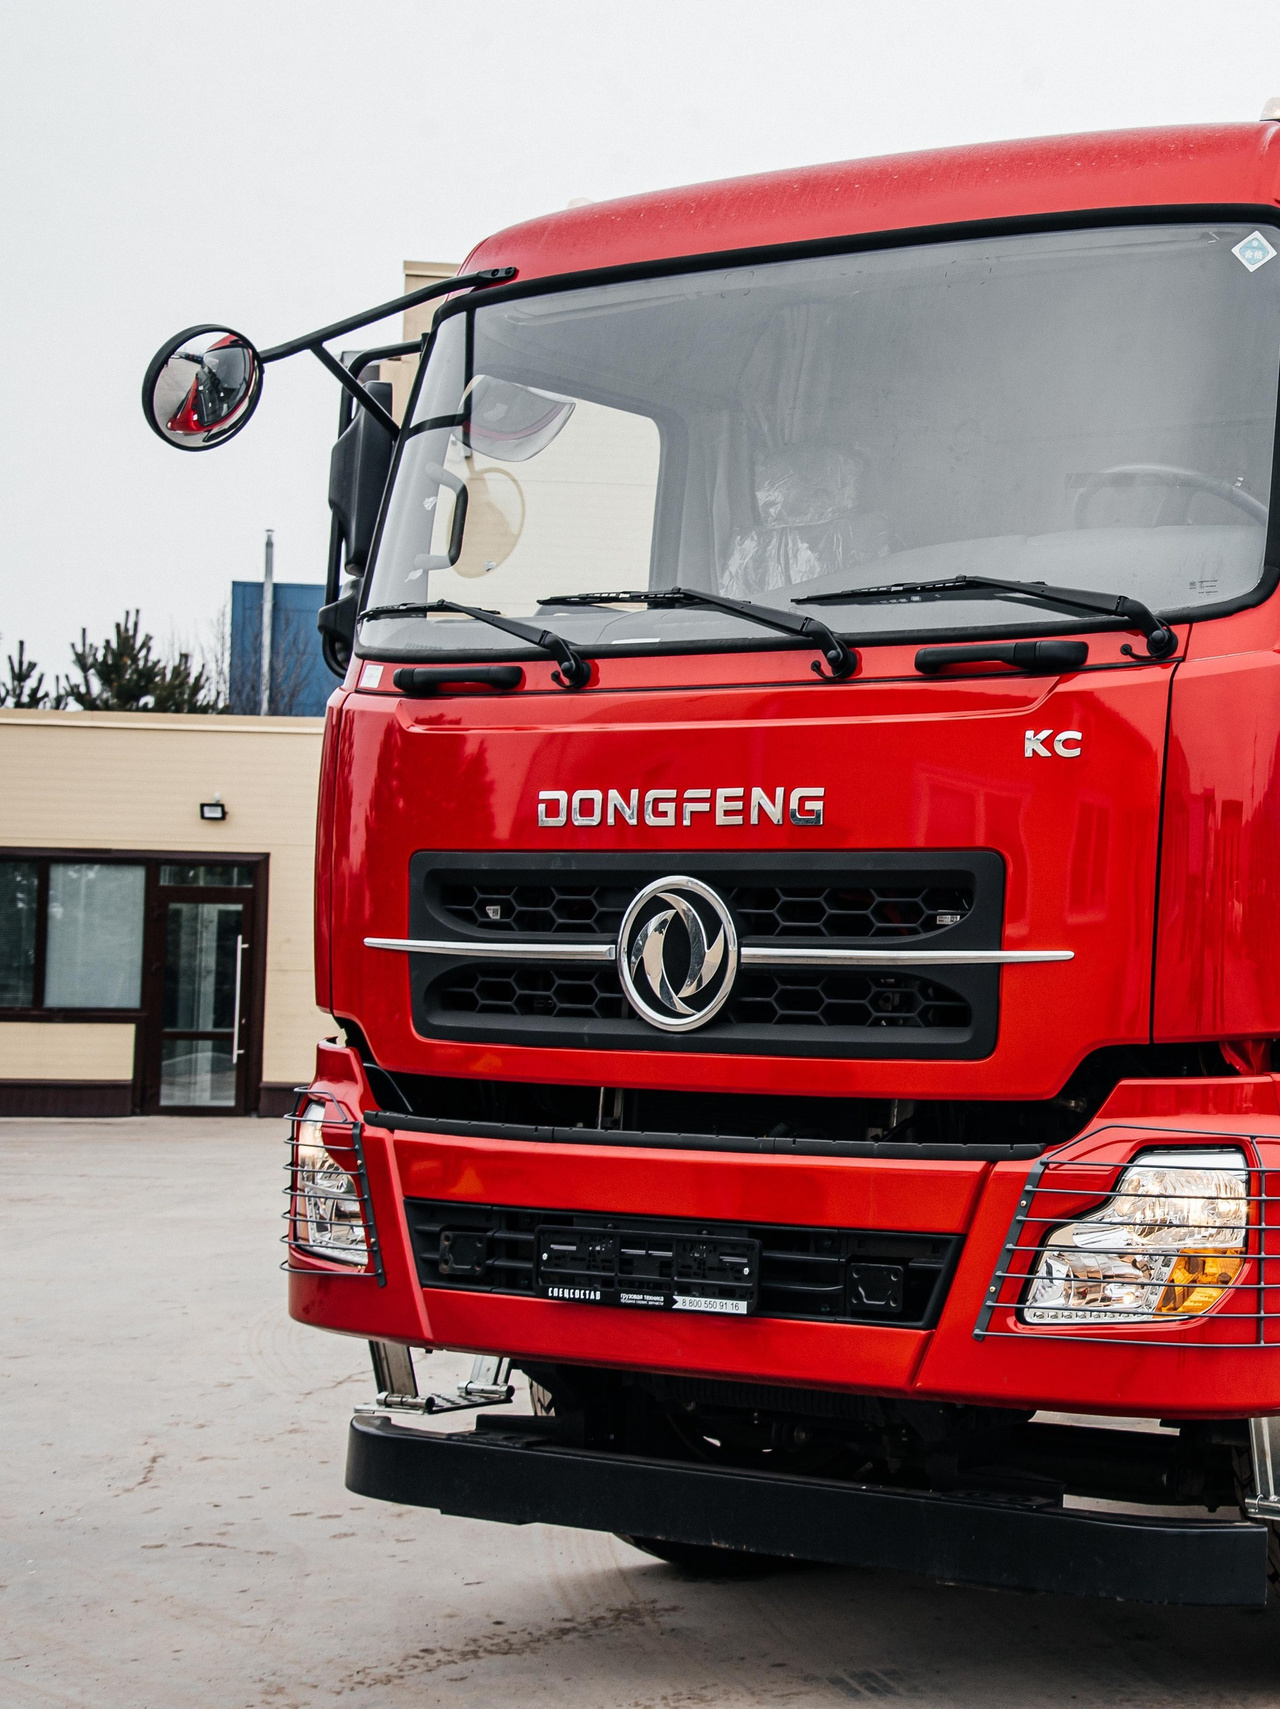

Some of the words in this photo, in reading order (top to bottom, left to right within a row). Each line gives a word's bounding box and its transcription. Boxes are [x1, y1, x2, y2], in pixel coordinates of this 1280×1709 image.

[1023, 728, 1083, 759] KC
[537, 786, 826, 828] DONGFENG
[548, 1287, 601, 1300] СПЕЦСОСТАВ
[620, 1293, 643, 1301] грузовая
[681, 1298, 687, 1307] 8
[688, 1299, 702, 1308] 800
[704, 1300, 717, 1309] 550
[719, 1301, 728, 1310] 91
[730, 1302, 740, 1311] 16
